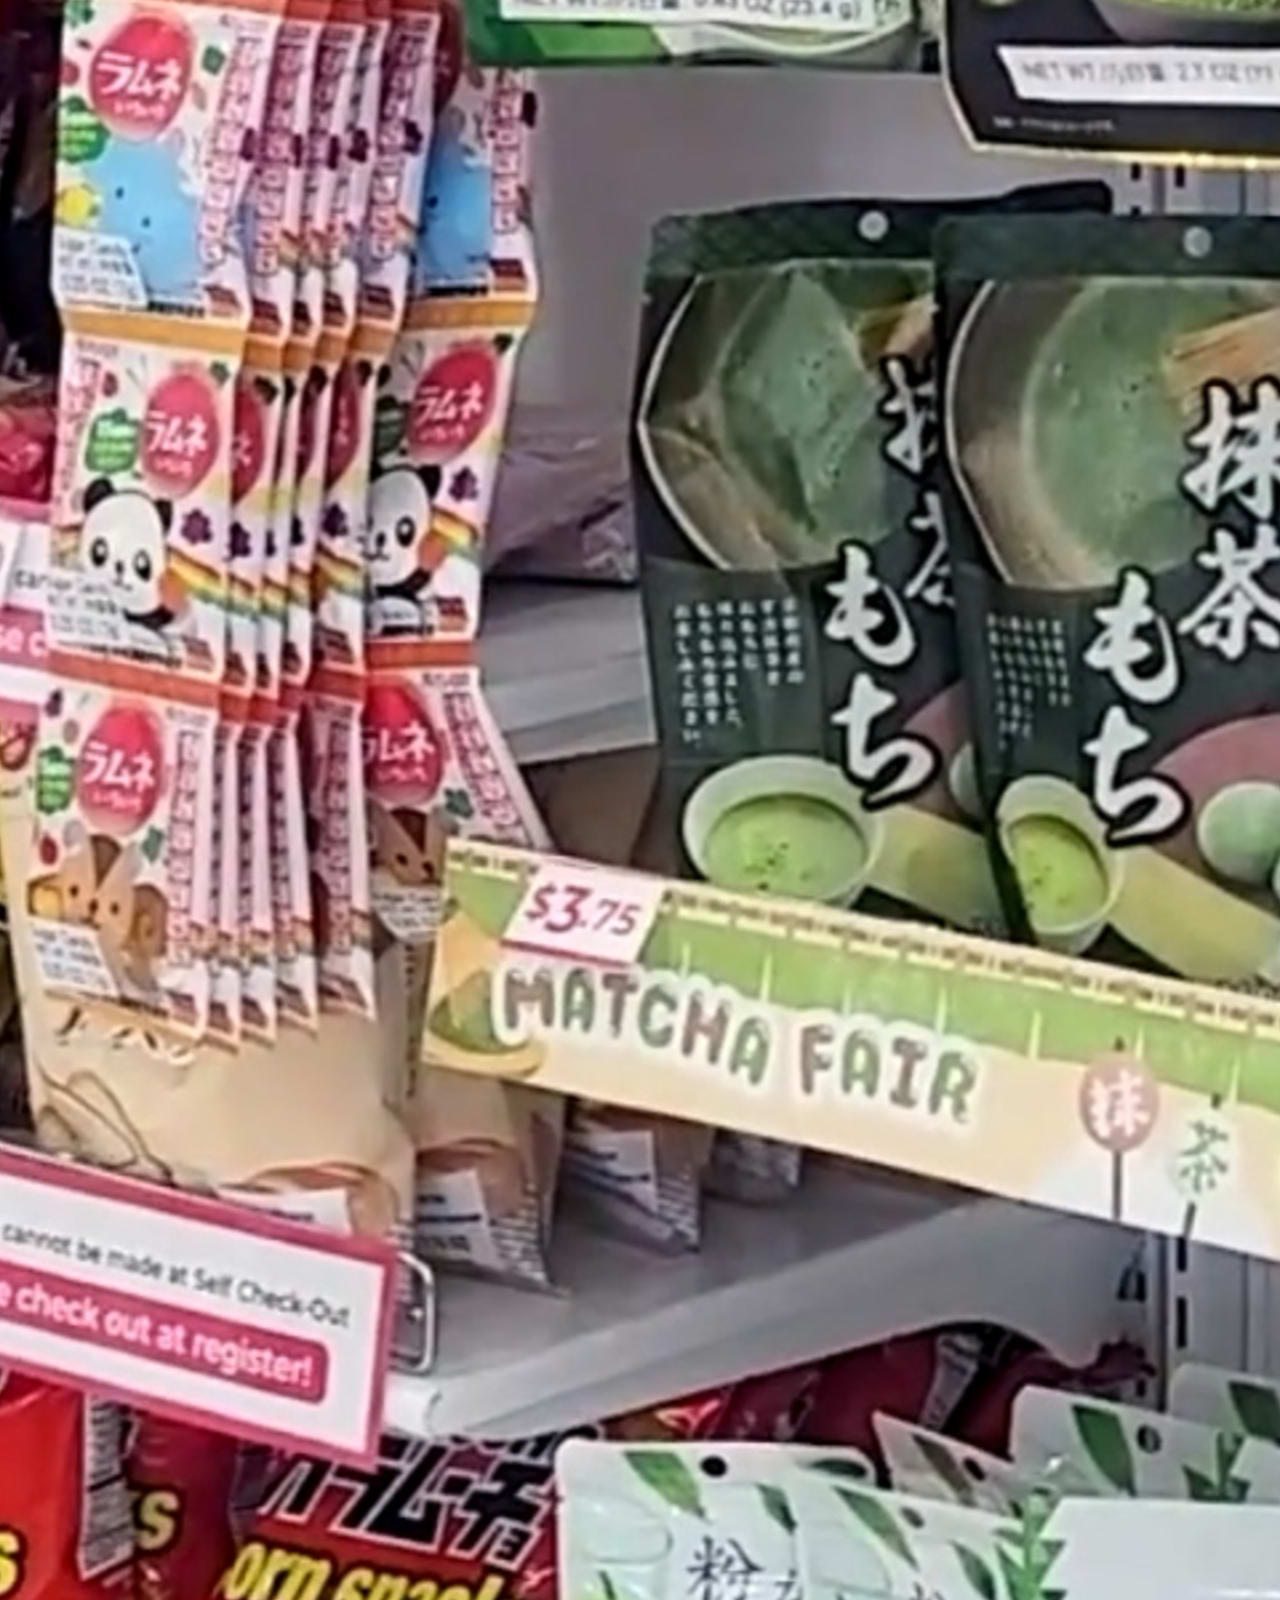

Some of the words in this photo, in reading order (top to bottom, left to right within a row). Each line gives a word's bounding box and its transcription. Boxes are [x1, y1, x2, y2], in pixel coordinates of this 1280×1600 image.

[96, 49, 182, 99] ラムネ
[144, 409, 207, 455] ラムネ
[418, 381, 483, 424] ラムネ
[823, 544, 938, 806] もち
[1083, 572, 1186, 841] もち
[81, 743, 156, 790] ラムネ
[524, 884, 641, 938] $3.75
[500, 969, 772, 1088] MATCHA
[798, 1021, 980, 1127] FAIR
[2, 1221, 78, 1263] cannot
[81, 1236, 104, 1262] be
[107, 1243, 164, 1277] made
[192, 1263, 233, 1295] Self
[15, 1283, 99, 1332] check
[104, 1308, 150, 1344] out
[155, 1320, 188, 1352] at
[192, 1328, 314, 1387] register!
